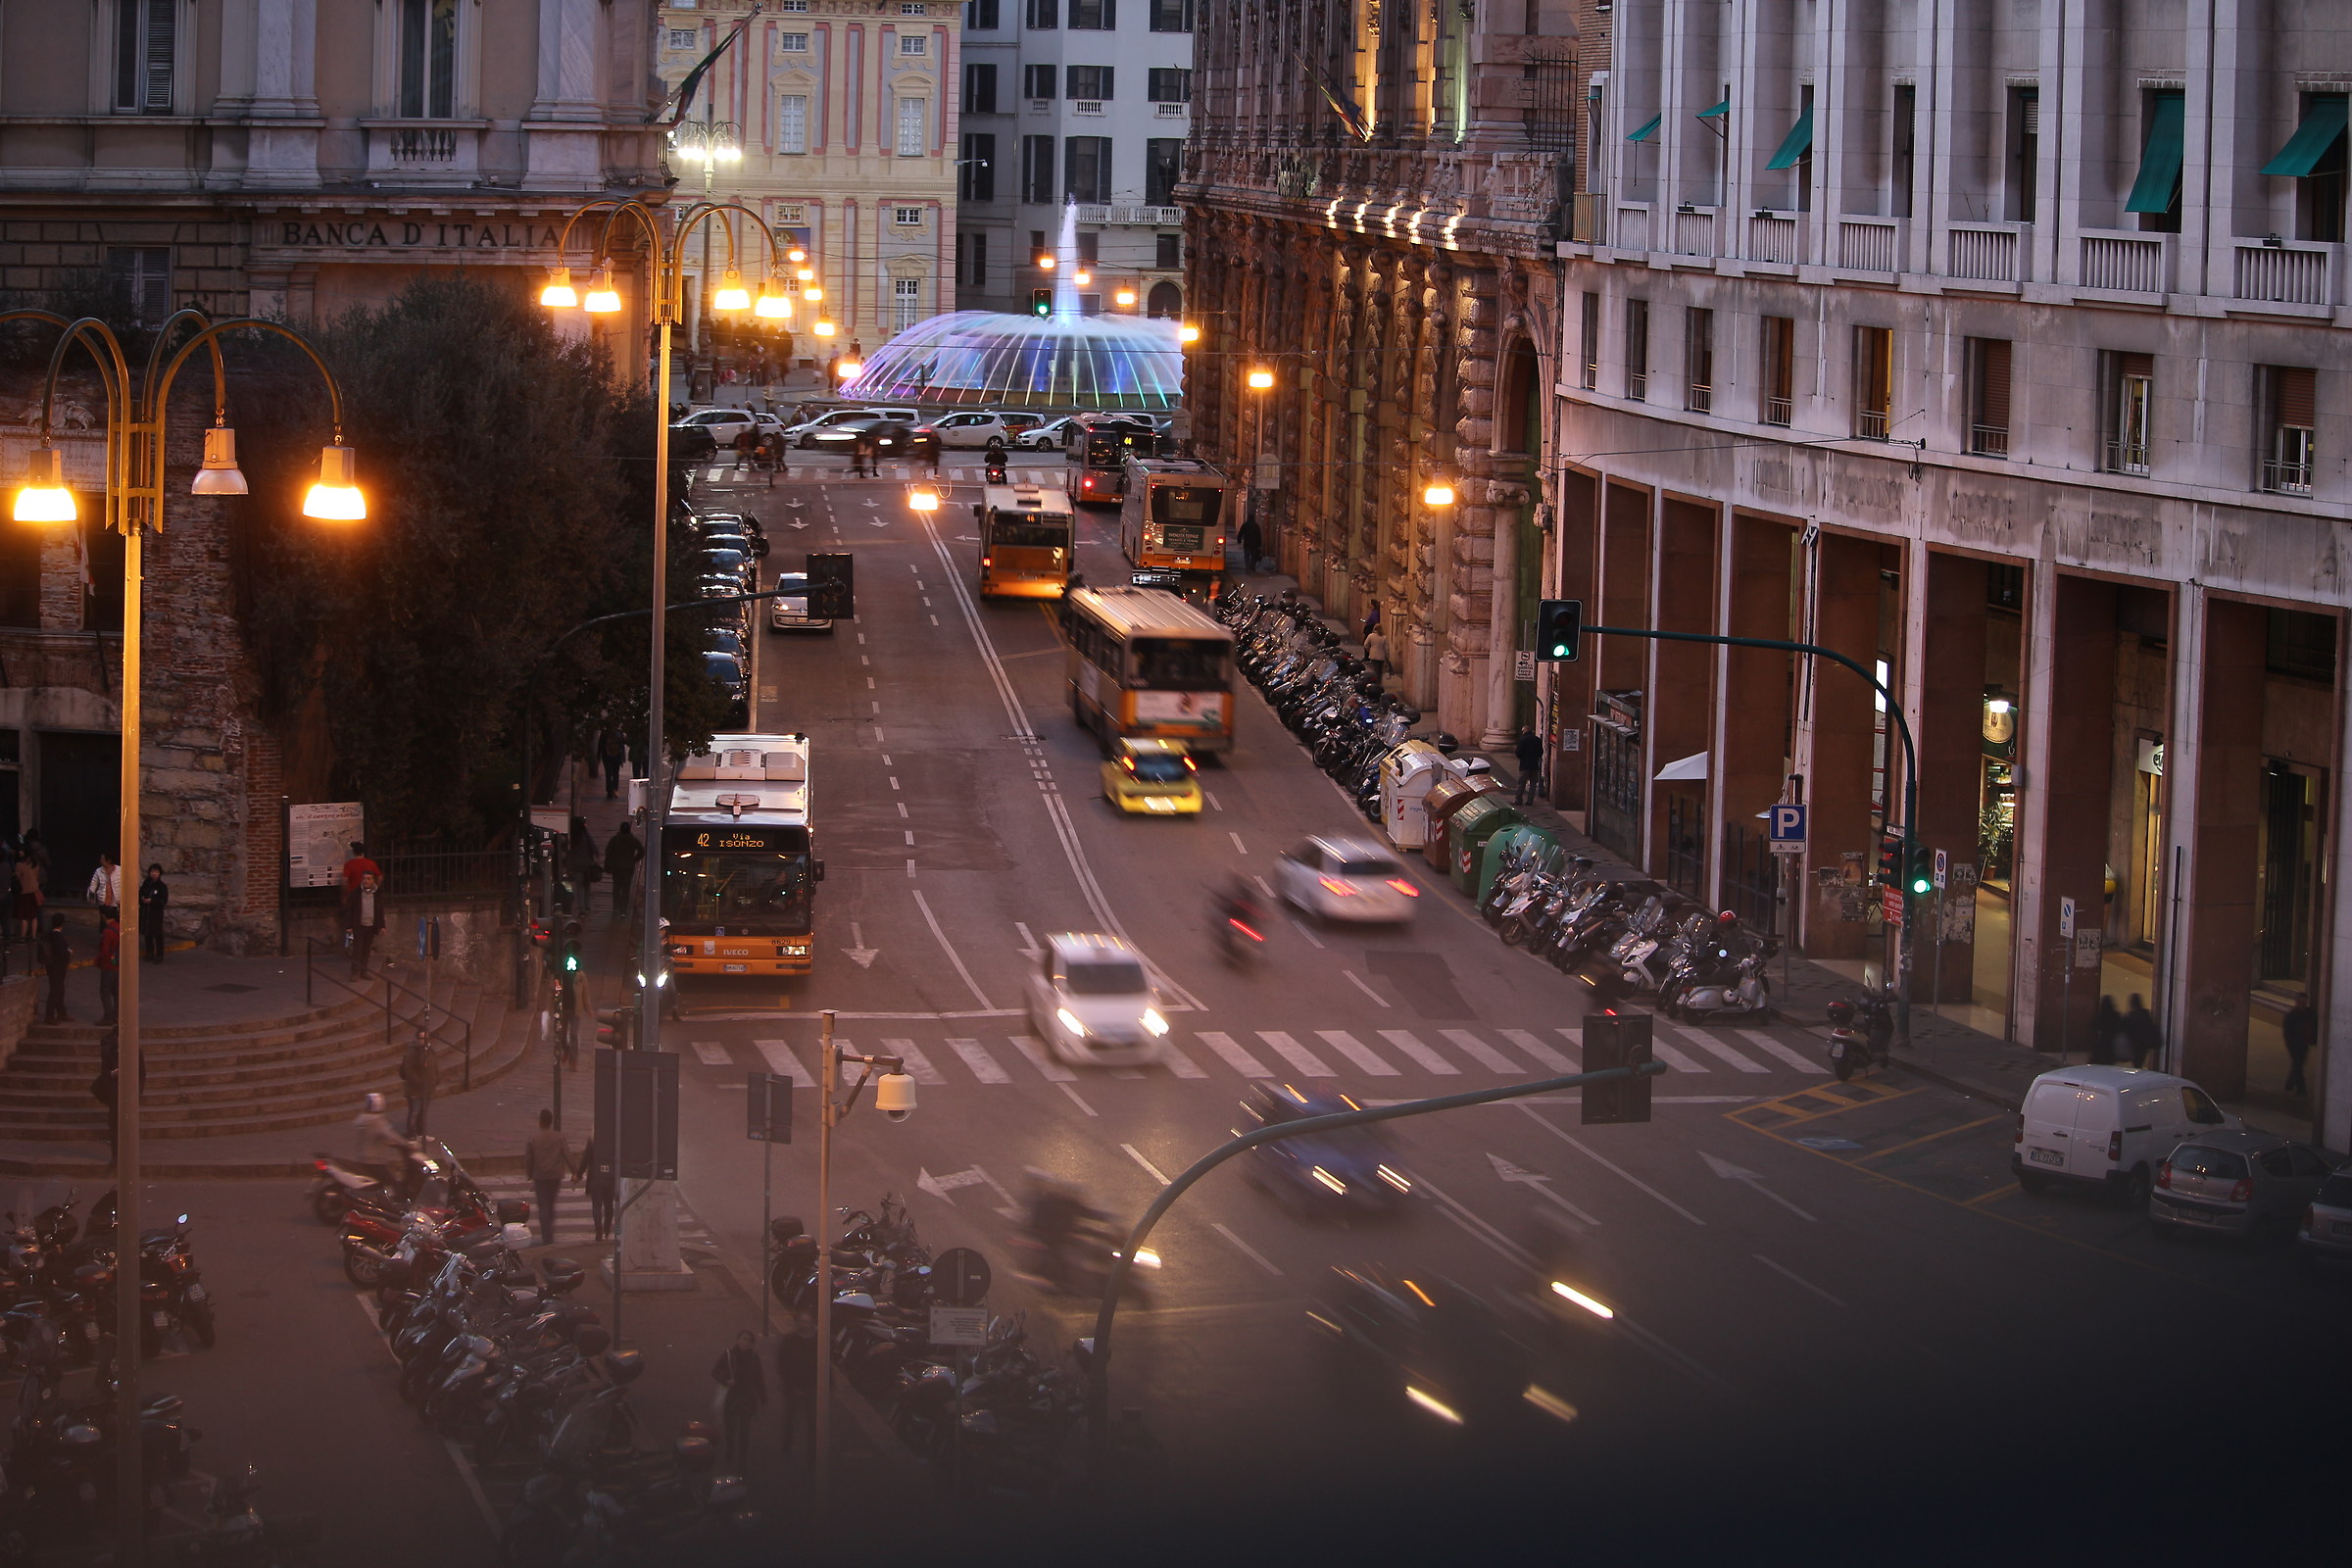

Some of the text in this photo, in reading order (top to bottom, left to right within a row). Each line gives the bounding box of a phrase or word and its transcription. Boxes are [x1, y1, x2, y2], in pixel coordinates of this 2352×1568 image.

[282, 221, 388, 246] BANCA
[1777, 808, 1800, 838] P
[697, 832, 710, 847] 42
